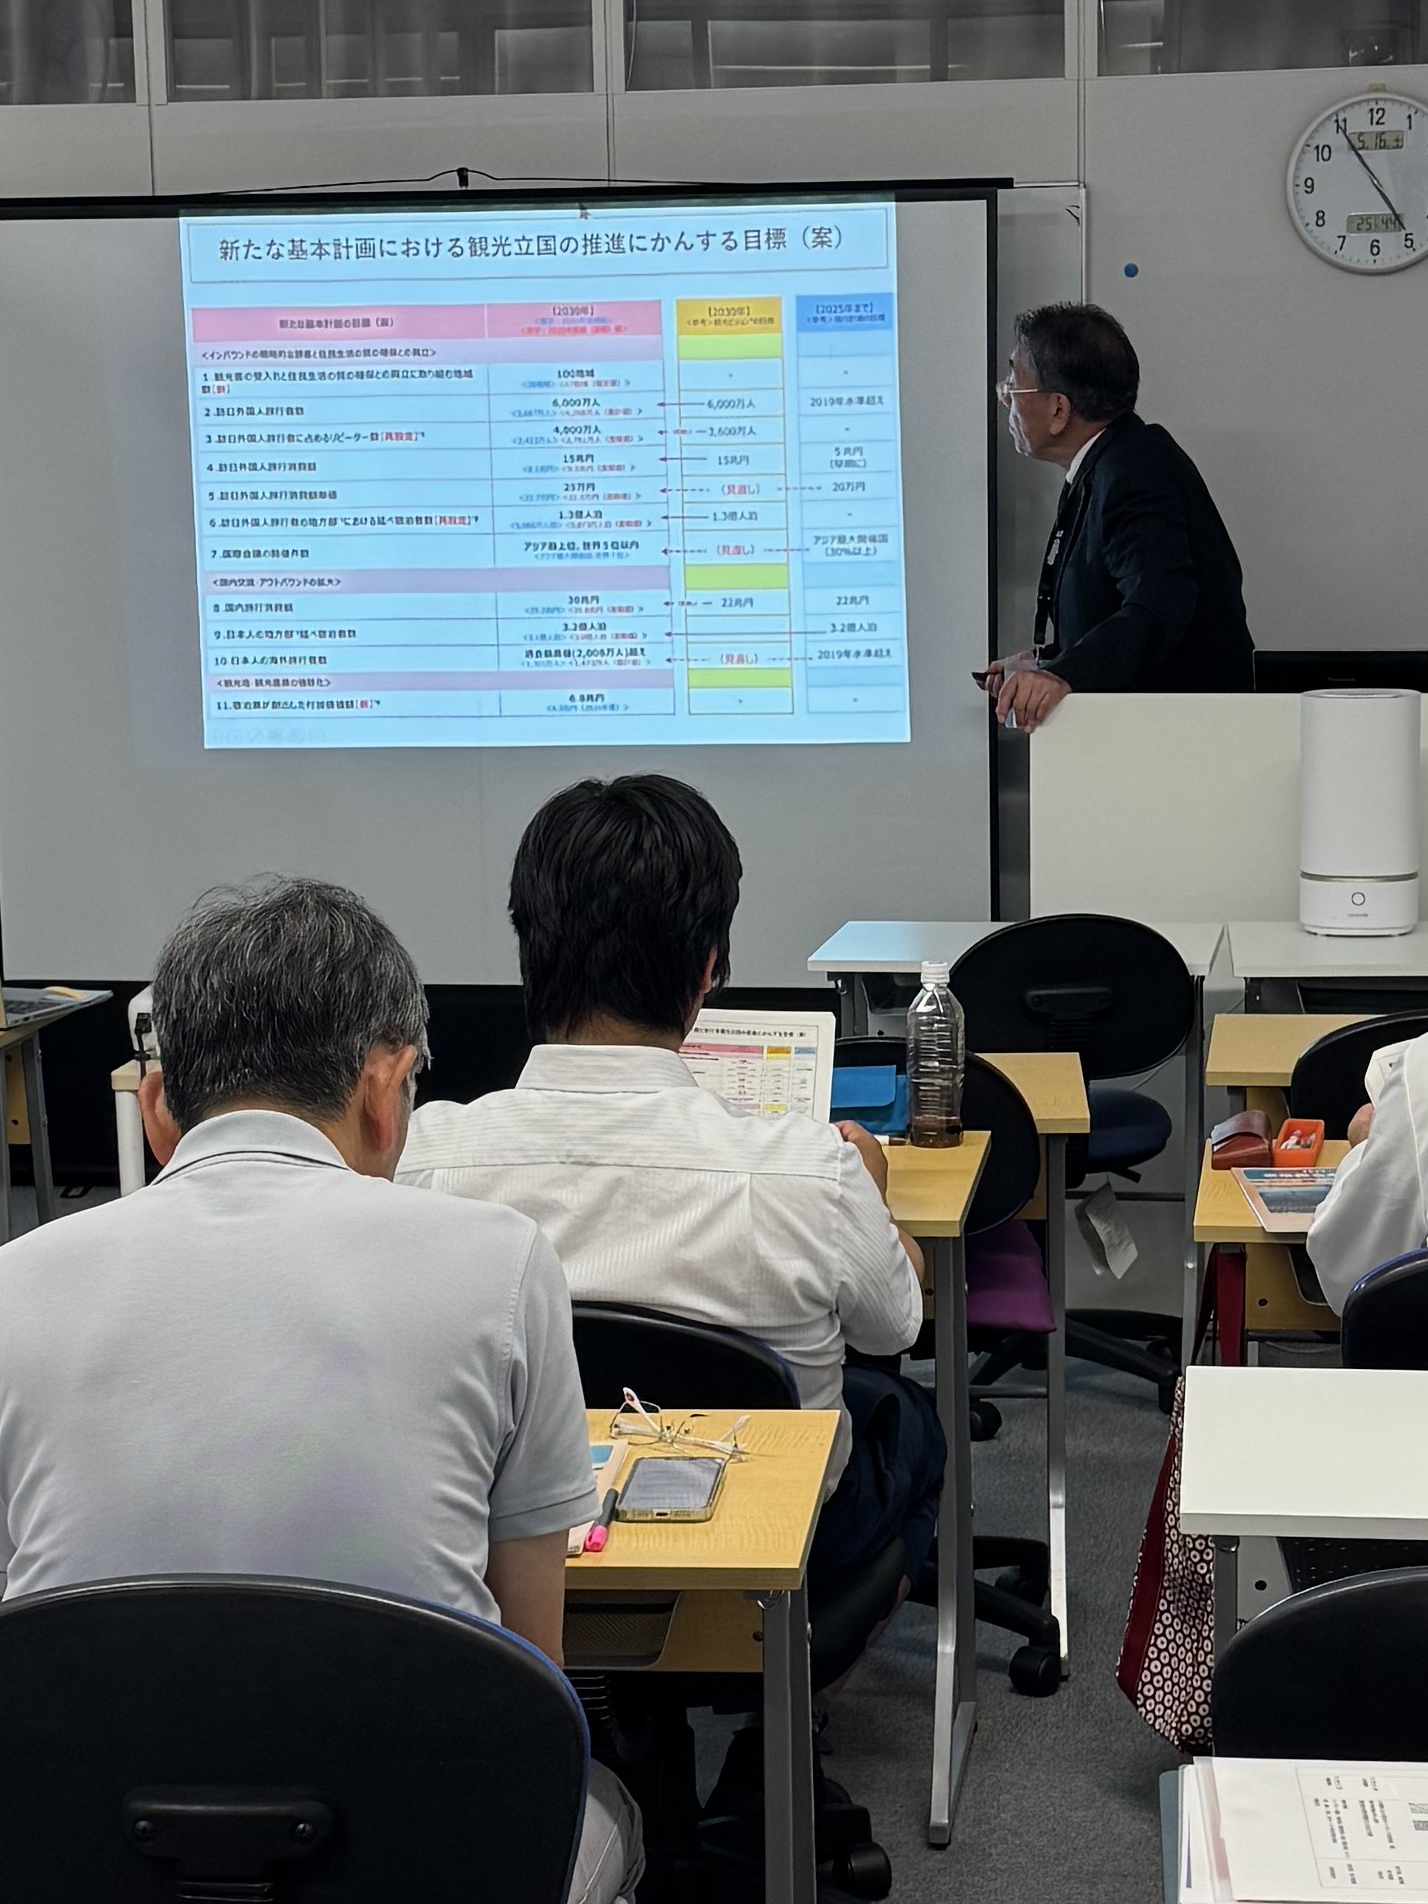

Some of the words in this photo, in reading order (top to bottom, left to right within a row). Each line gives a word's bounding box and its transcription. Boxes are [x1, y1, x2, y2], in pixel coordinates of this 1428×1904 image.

[1368, 107, 1386, 126] 12
[1406, 114, 1413, 130] 1
[1314, 144, 1332, 162] 10
[1304, 177, 1315, 195] 9
[1315, 210, 1326, 228] 8
[220, 224, 844, 262] 新たな基本計画における観光立国の推進にかんする目標（案）
[1337, 235, 1347, 251] 7
[1370, 239, 1381, 257] 6
[1404, 232, 1415, 249] 5
